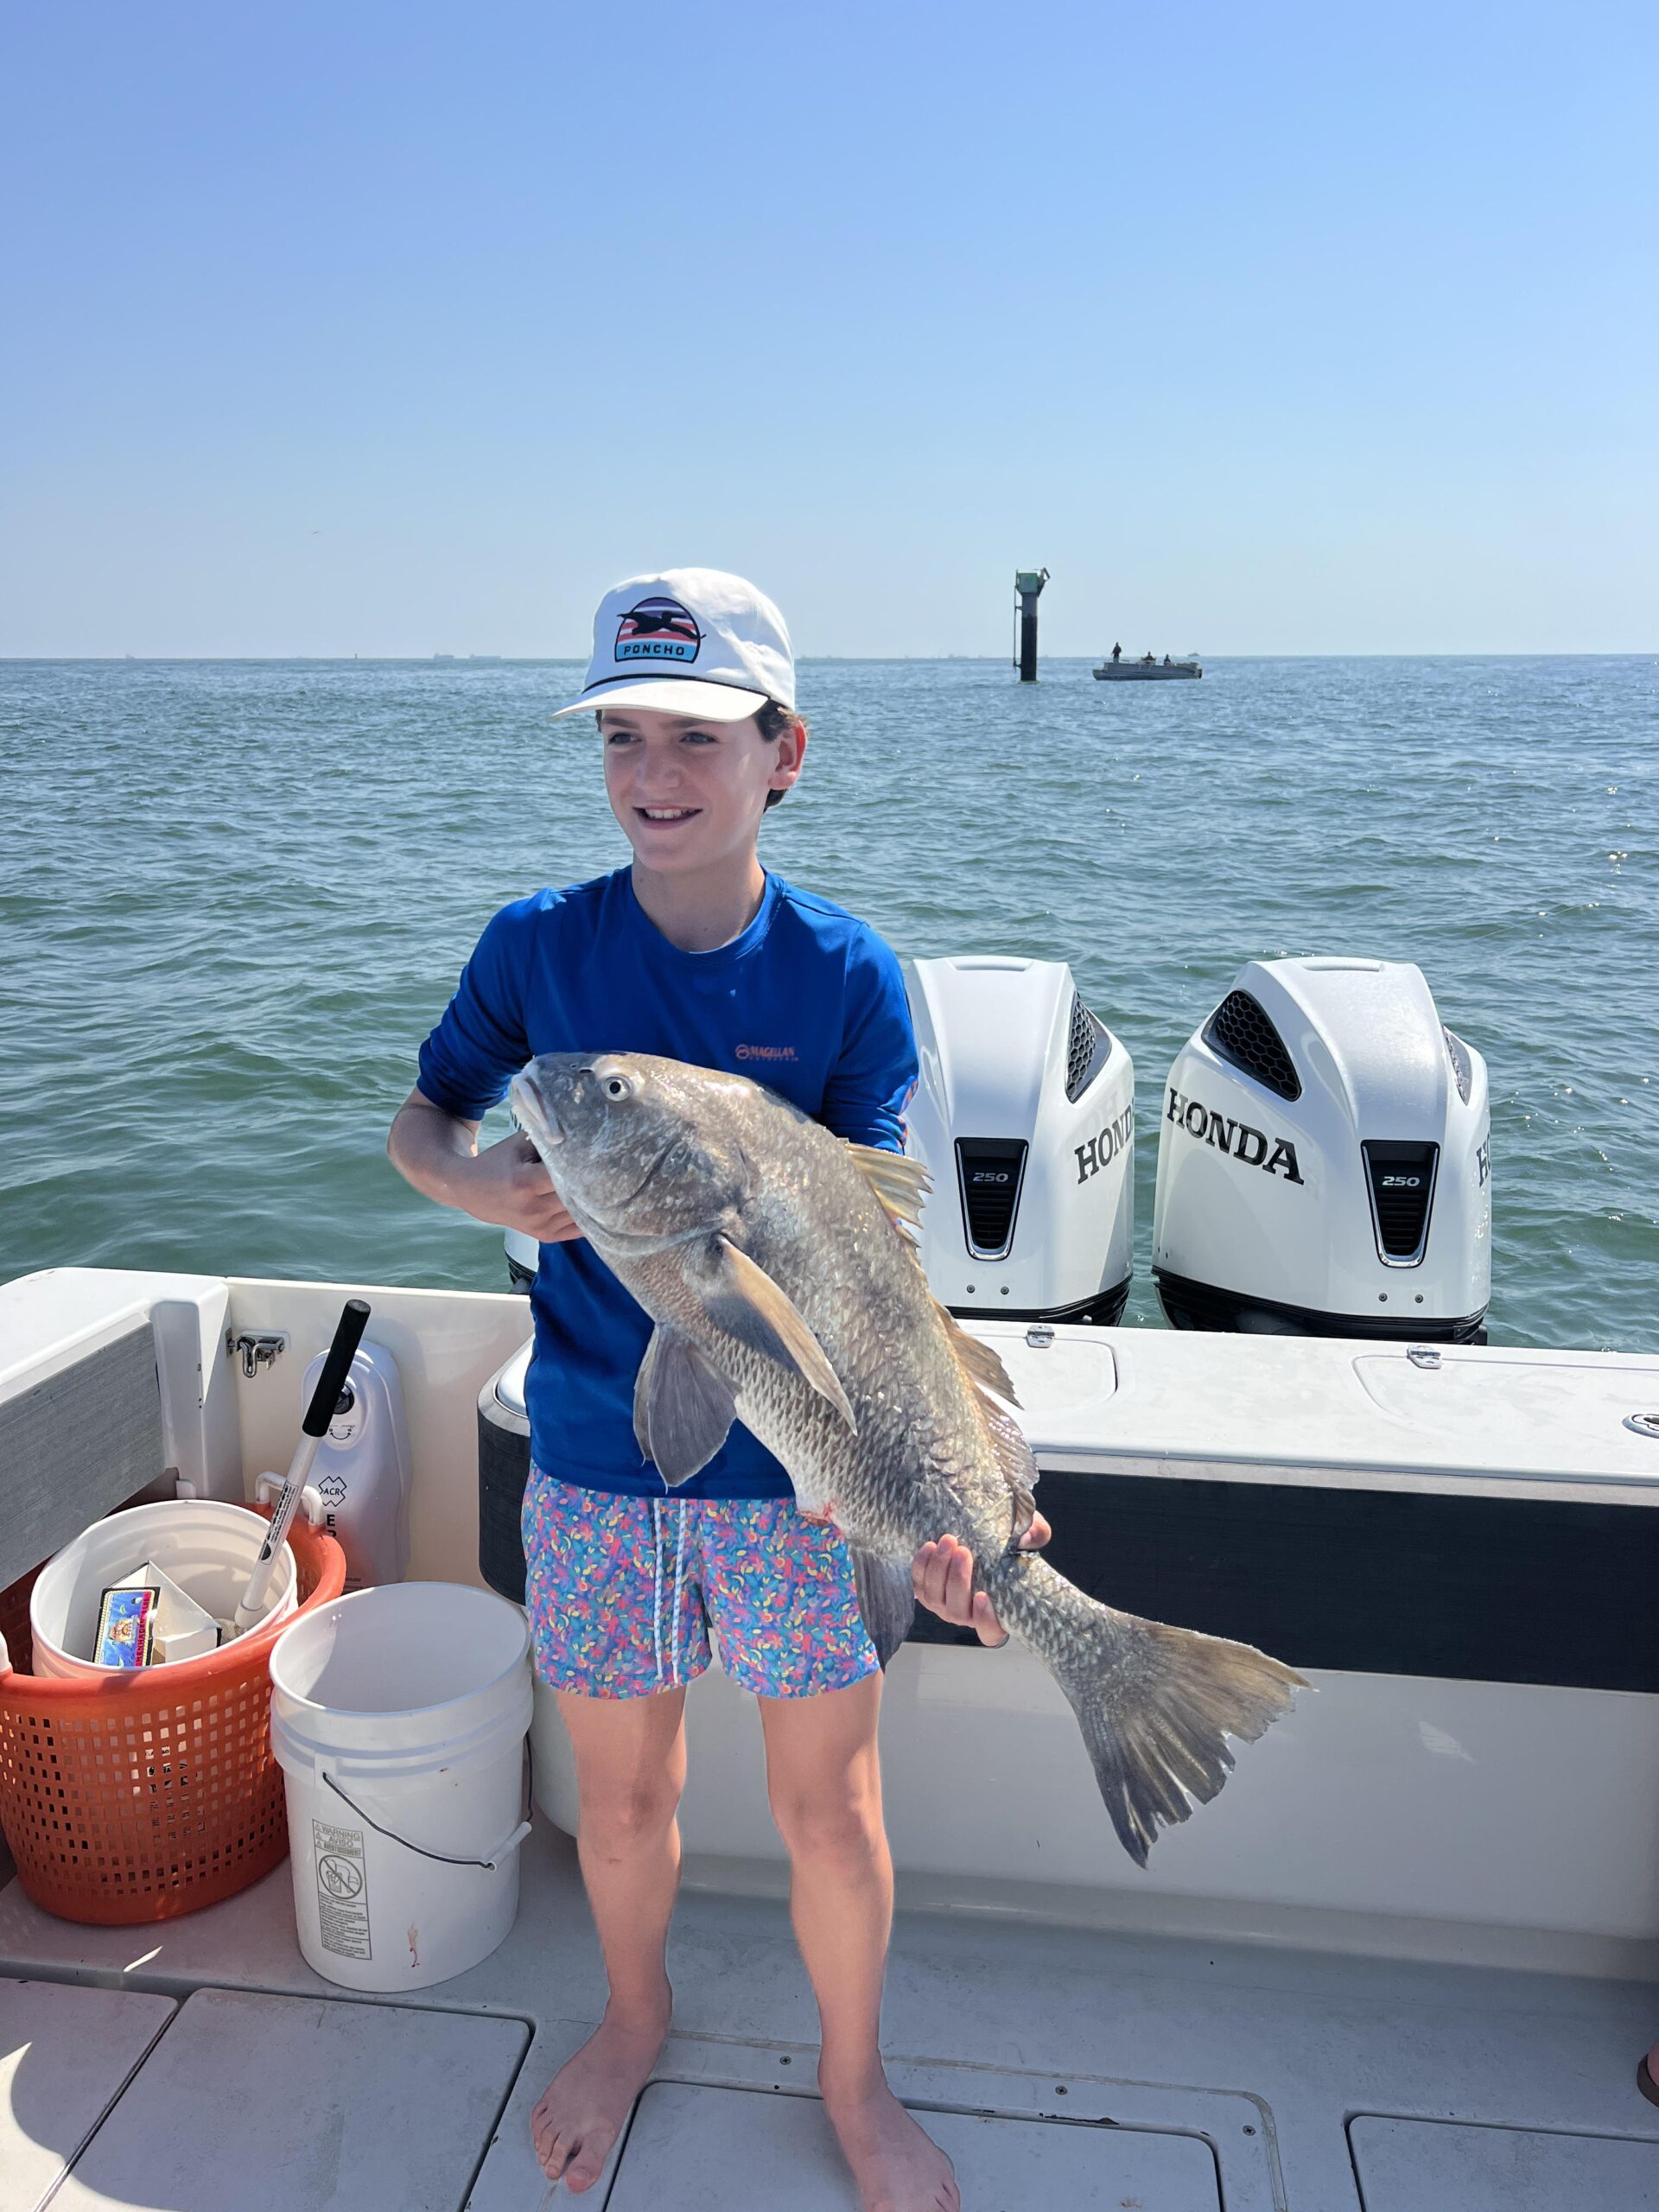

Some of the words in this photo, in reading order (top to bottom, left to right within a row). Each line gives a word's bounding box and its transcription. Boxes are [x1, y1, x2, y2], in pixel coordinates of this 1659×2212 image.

[623, 644, 685, 656] PONCHO
[749, 1046, 796, 1058] MAGELLAN
[1074, 1098, 1135, 1185] HOND
[1166, 1087, 1305, 1185] HONDA
[973, 1172, 1009, 1183] 250
[1382, 1176, 1421, 1187] 250
[323, 1487, 340, 1496] ACR
[136, 1618, 145, 1662] MENHADEN
[321, 1824, 361, 1840] WARNING
[328, 1836, 353, 1847] AVISO
